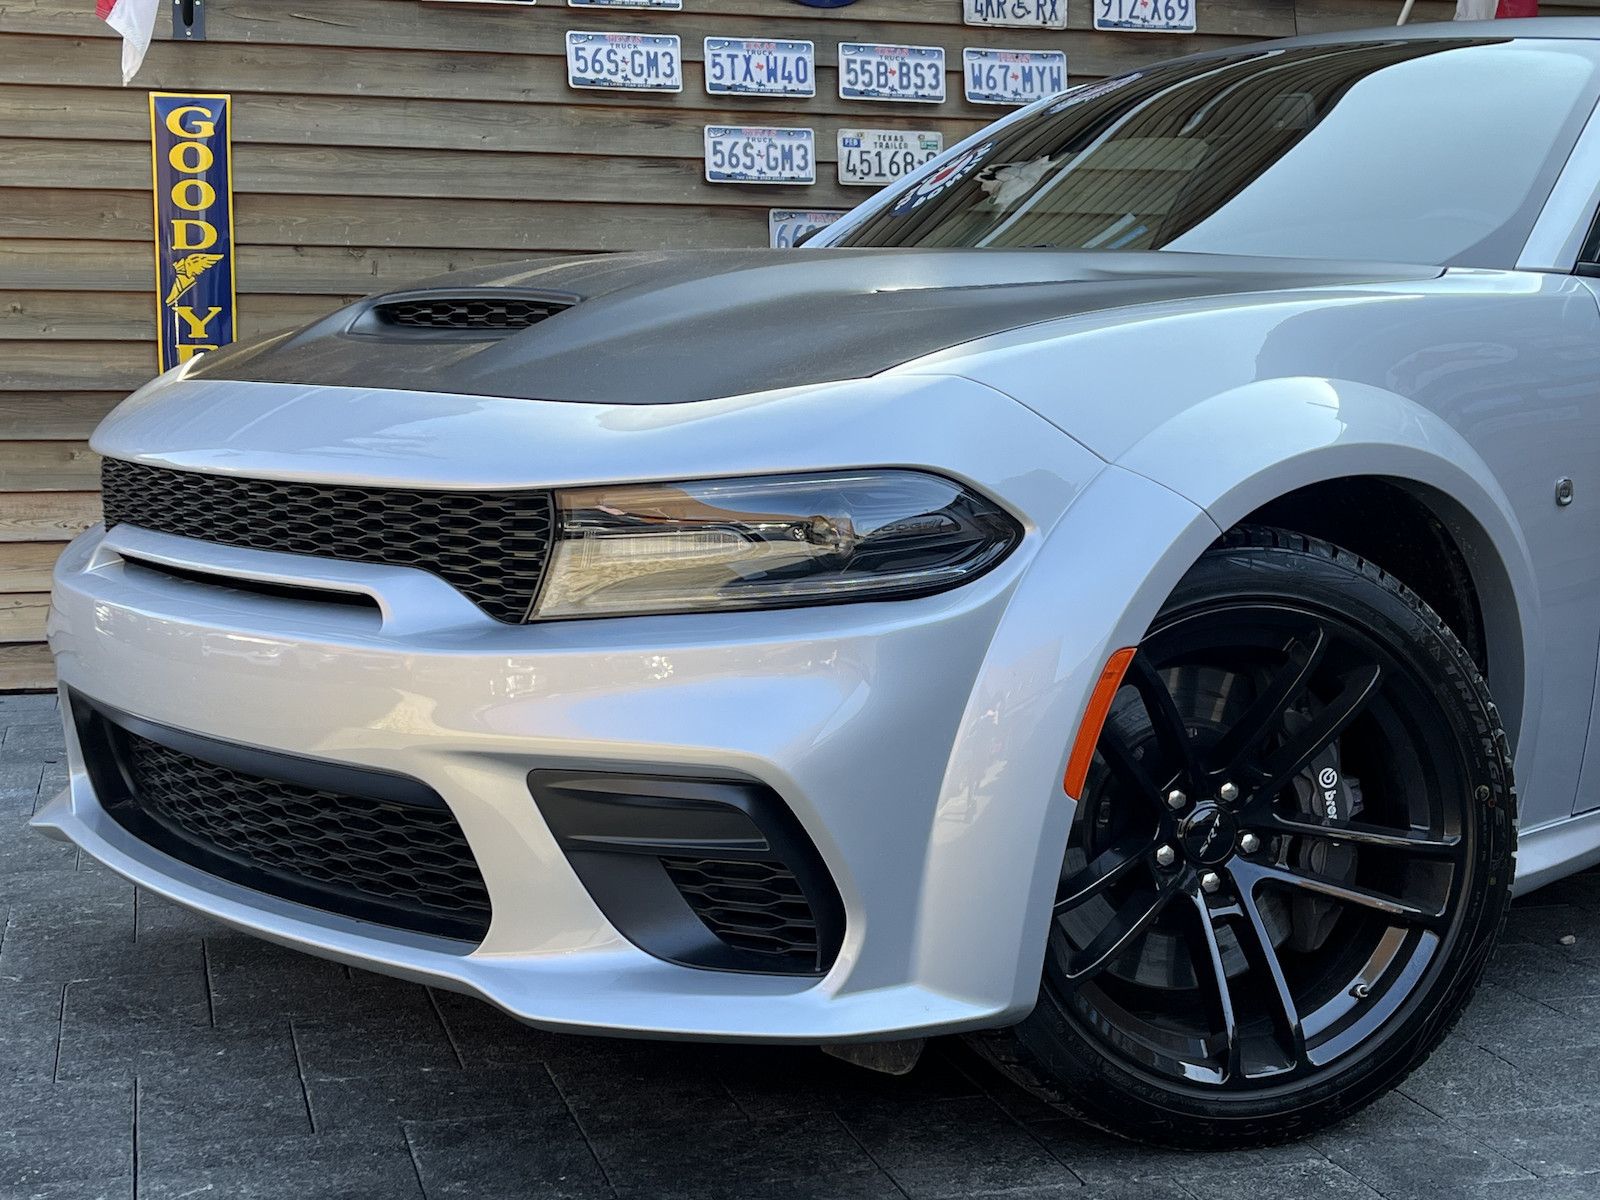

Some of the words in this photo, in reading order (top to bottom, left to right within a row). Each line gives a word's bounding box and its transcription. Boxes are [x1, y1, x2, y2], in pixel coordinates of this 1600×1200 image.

[575, 47, 619, 76] 56S
[631, 49, 675, 78] GM3
[711, 53, 754, 82] 5TX
[846, 59, 888, 88] 55B
[899, 61, 940, 90] BS3
[971, 63, 1010, 91] W67
[1021, 65, 1061, 93] MYW
[874, 141, 908, 149] TRAILER
[877, 134, 904, 142] TEXAS
[712, 140, 755, 170] 56S
[766, 143, 809, 172] GM3
[846, 150, 915, 177] 45168
